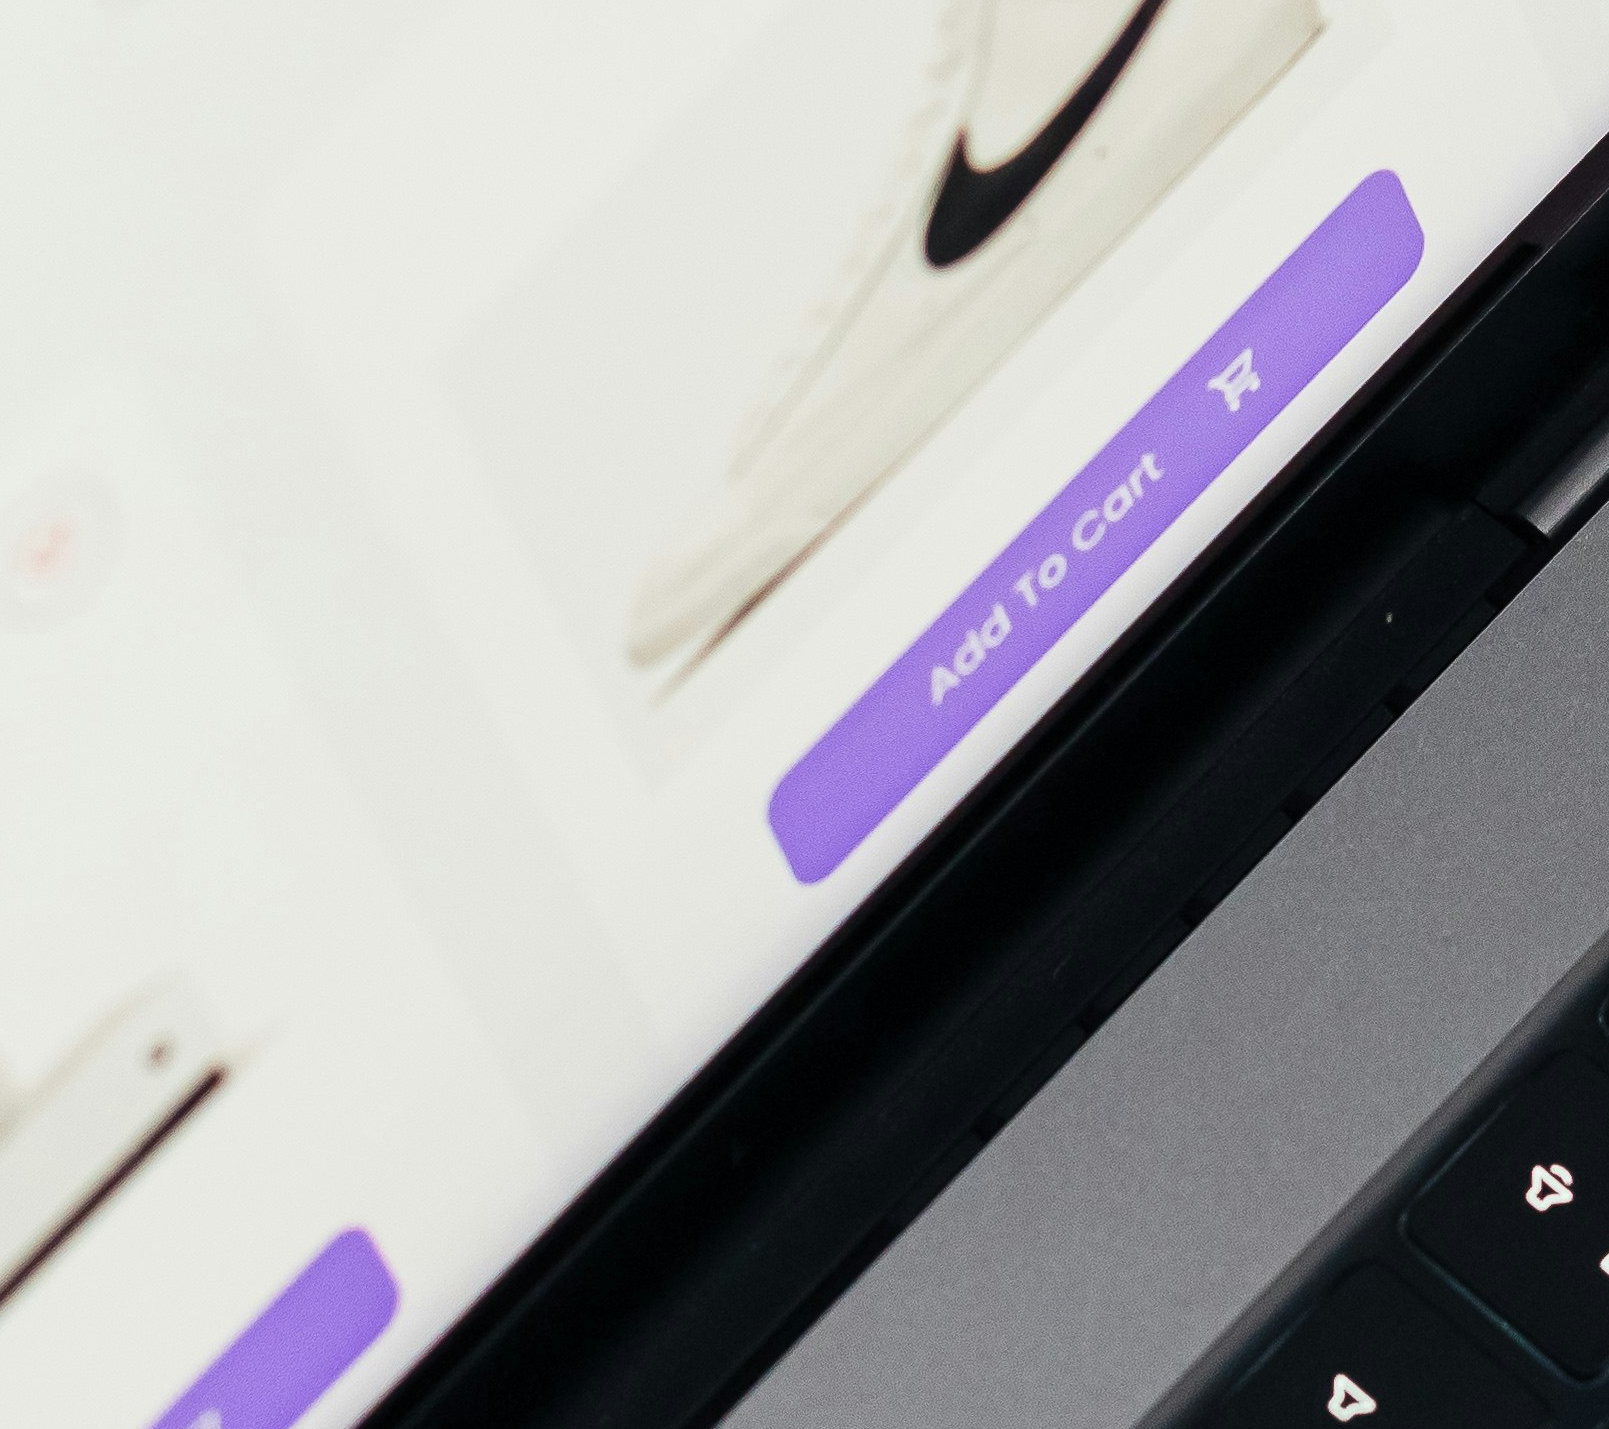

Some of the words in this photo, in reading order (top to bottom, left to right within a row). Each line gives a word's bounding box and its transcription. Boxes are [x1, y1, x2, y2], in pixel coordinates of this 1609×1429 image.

[928, 604, 1012, 706] Add
[1013, 552, 1068, 608] To
[1070, 451, 1165, 553] Cart
